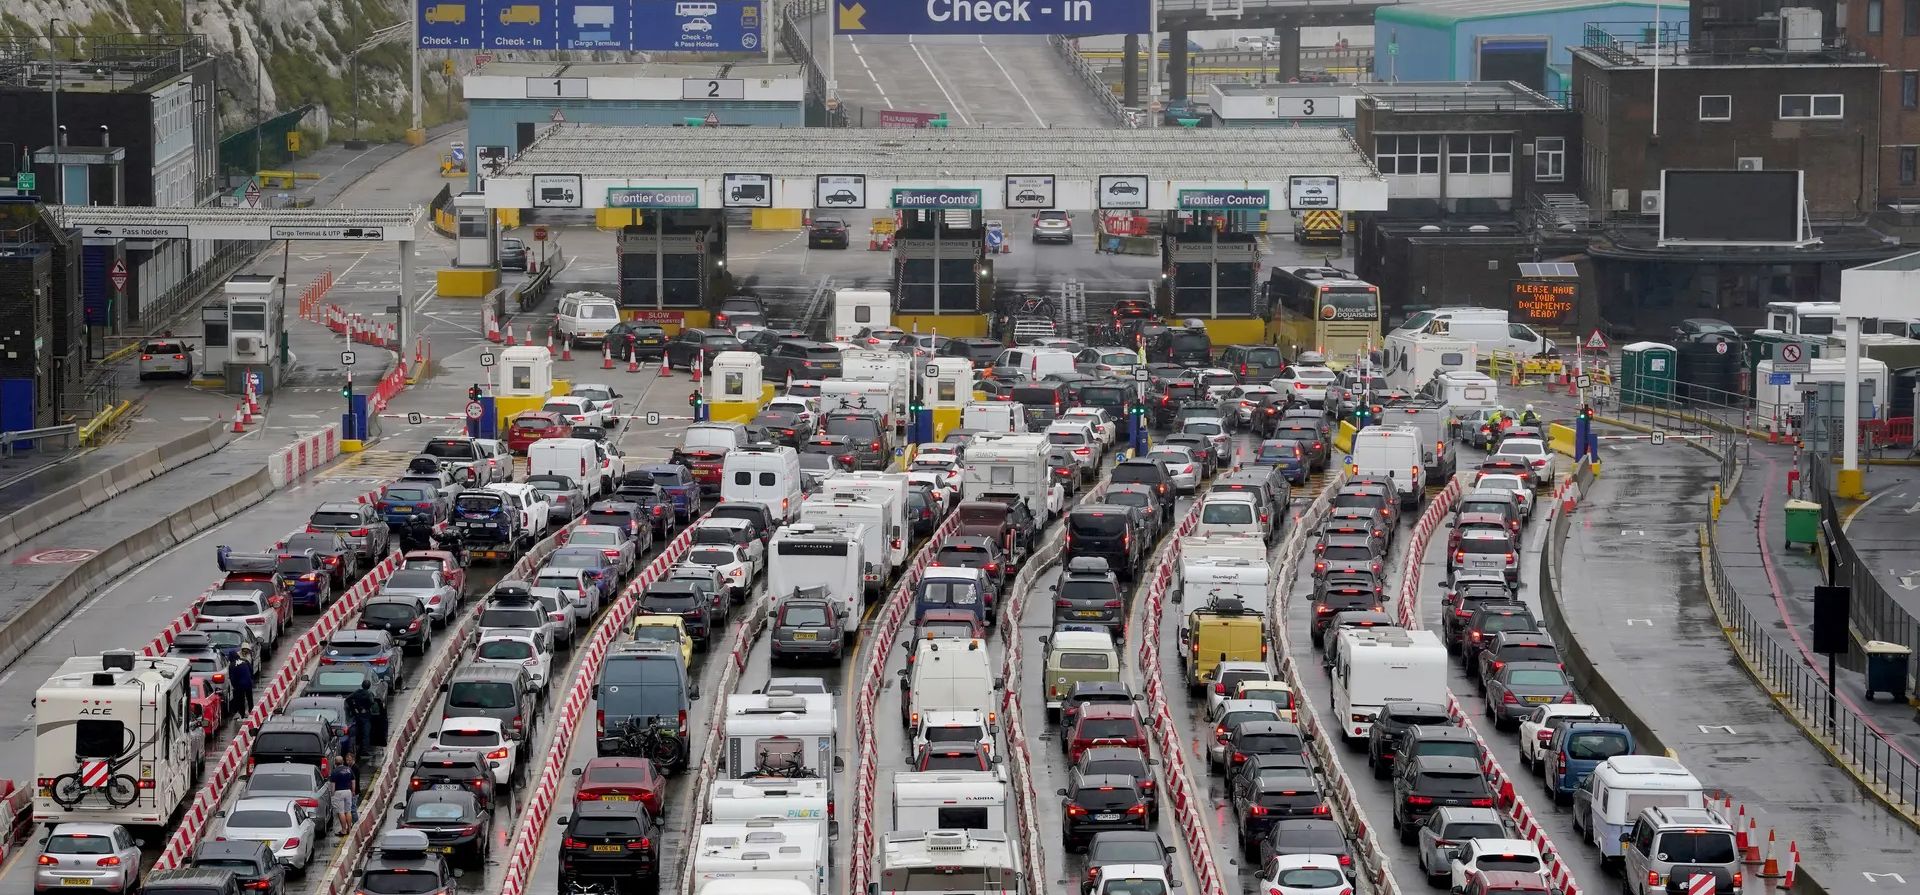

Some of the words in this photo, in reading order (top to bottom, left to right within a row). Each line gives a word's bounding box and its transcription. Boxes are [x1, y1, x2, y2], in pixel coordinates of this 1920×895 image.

[926, 0, 1031, 21] Check
[422, 36, 452, 45] Check
[460, 36, 470, 45] In
[495, 37, 525, 46] Check
[533, 37, 542, 46] In
[574, 40, 594, 48] Cargo
[552, 79, 562, 96] 1
[707, 81, 719, 98] 2
[1303, 99, 1315, 116] 3
[612, 193, 653, 203] Frontier
[655, 193, 695, 203] Control
[895, 194, 937, 204] Frontier
[939, 194, 978, 204] Control
[1183, 195, 1225, 205] Frontier
[1227, 194, 1266, 205] Control
[121, 228, 139, 236] Pass
[141, 227, 169, 236] holders
[276, 230, 294, 238] Cargo
[1516, 284, 1549, 293] PLEASE
[1552, 286, 1575, 295] HAVE
[1534, 293, 1555, 302] YOUR
[1519, 300, 1571, 310] DOCUMENTS
[1531, 309, 1557, 318] READY
[78, 707, 113, 716] ACE
